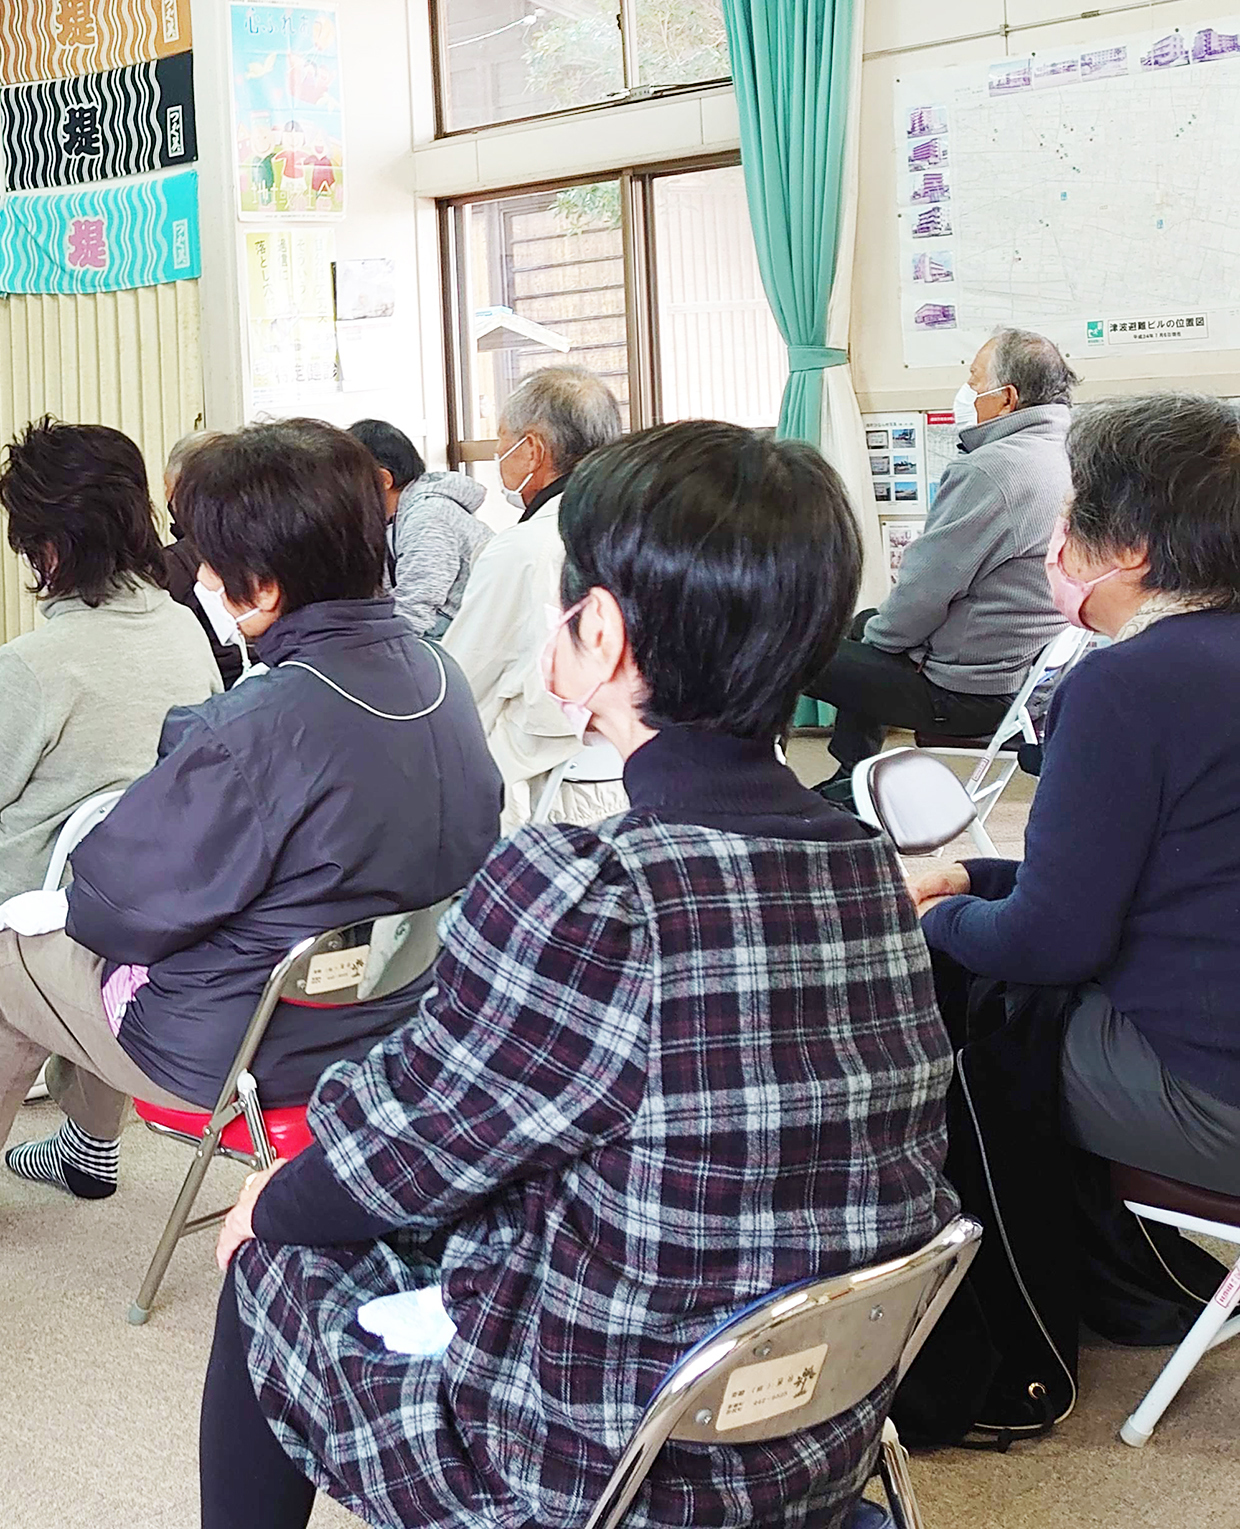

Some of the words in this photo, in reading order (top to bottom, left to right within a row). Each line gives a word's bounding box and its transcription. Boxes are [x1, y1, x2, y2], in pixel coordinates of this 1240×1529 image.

[1109, 316, 1205, 333] 津波避難ビルの位置図
